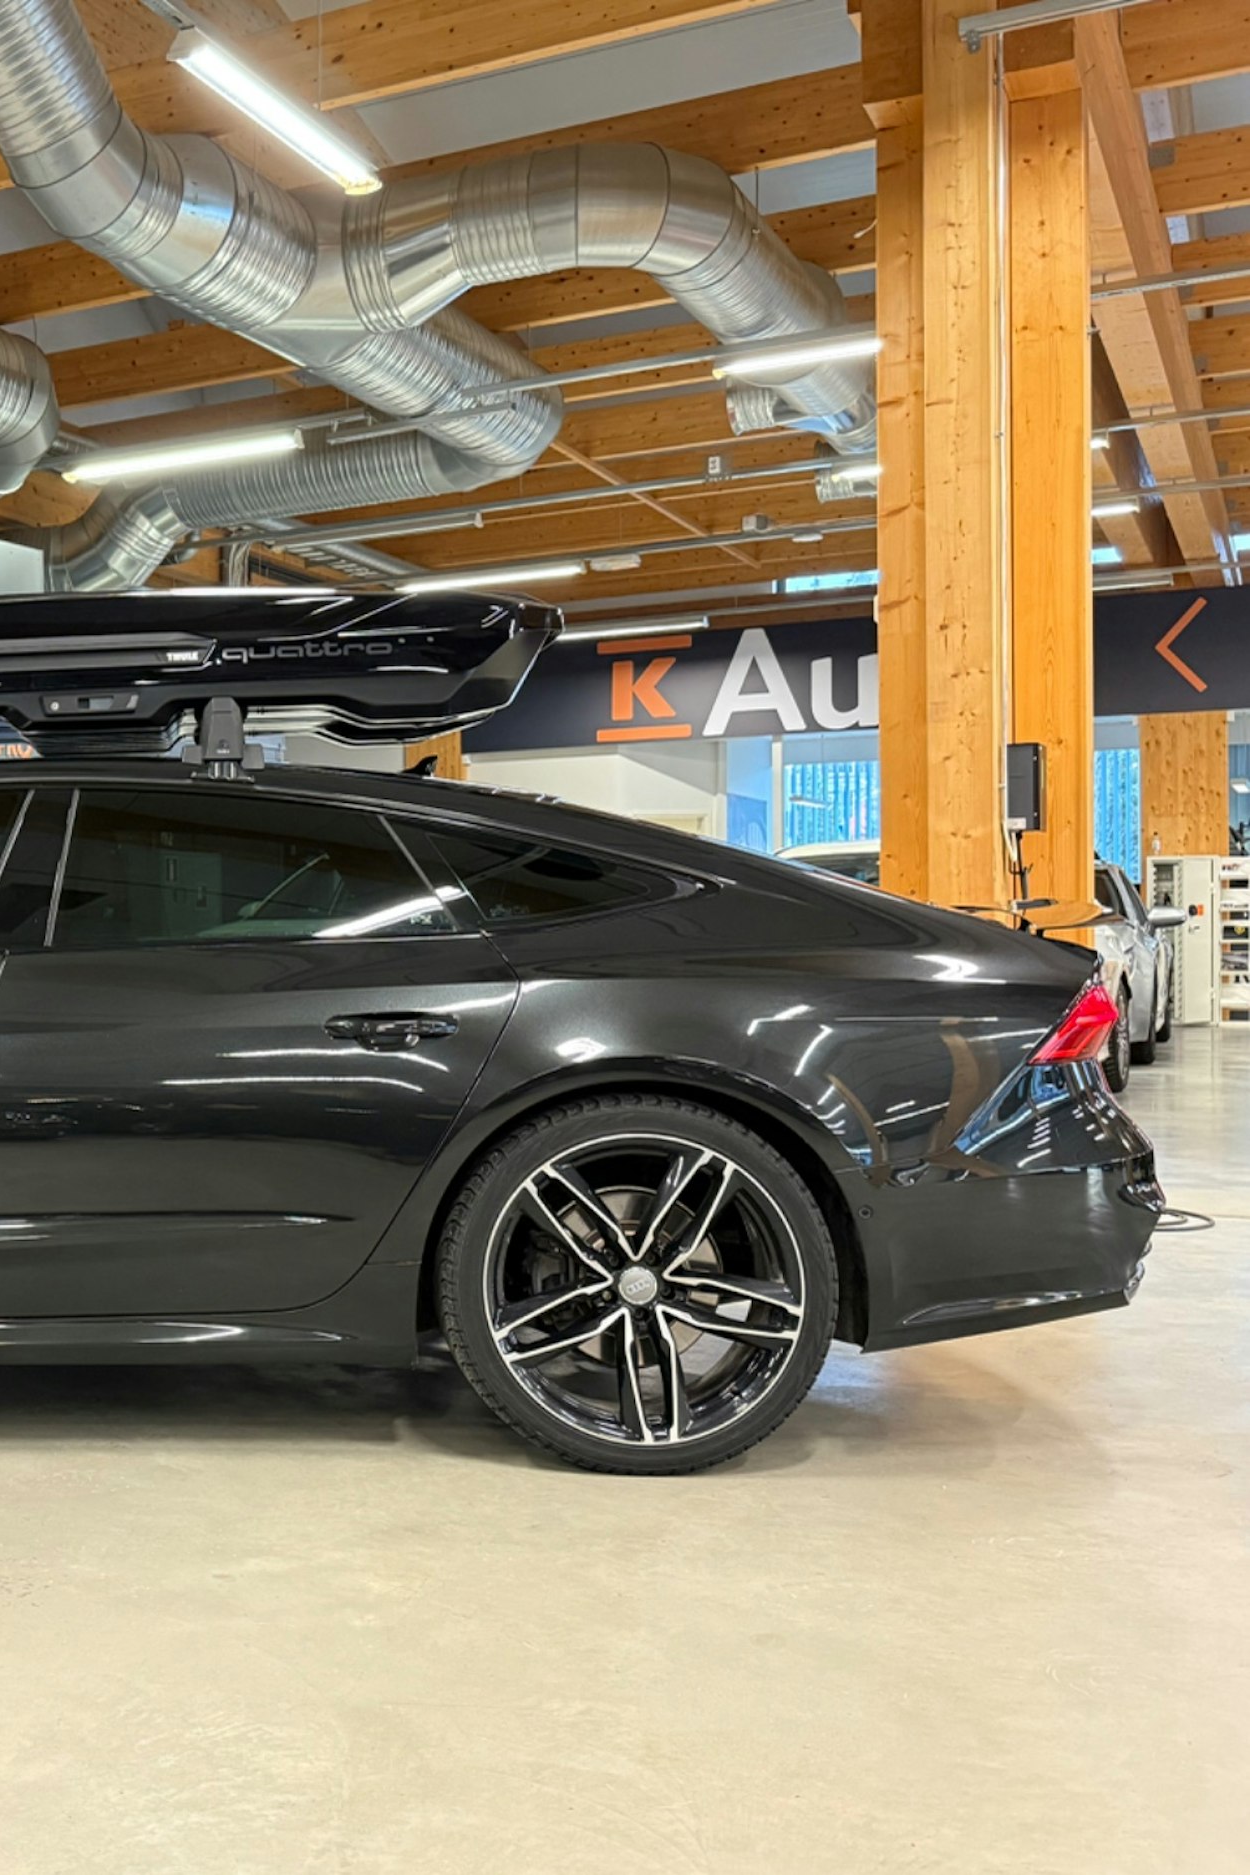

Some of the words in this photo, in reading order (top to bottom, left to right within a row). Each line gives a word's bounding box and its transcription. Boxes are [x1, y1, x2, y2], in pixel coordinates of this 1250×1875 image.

[221, 641, 393, 664] quattro
[611, 656, 677, 721] K
[702, 627, 880, 738] Au
